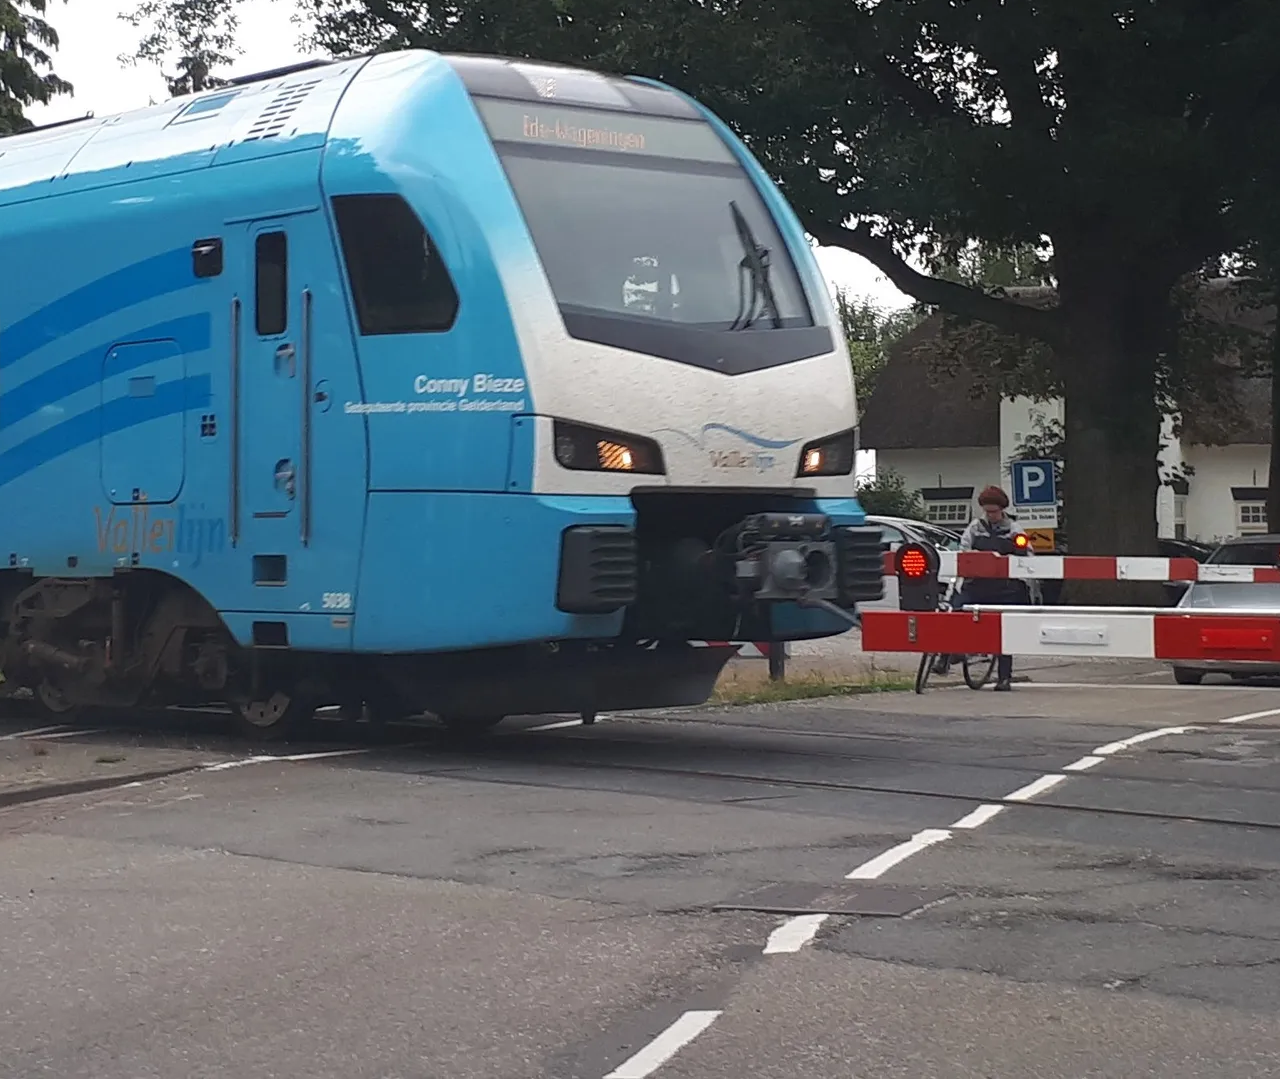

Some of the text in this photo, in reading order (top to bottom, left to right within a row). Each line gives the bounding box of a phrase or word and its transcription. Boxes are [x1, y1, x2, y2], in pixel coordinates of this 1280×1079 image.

[414, 374, 525, 397] Conny Bieze
[408, 399, 457, 414] provincie
[459, 398, 525, 413] Gelderland
[1022, 466, 1045, 500] P
